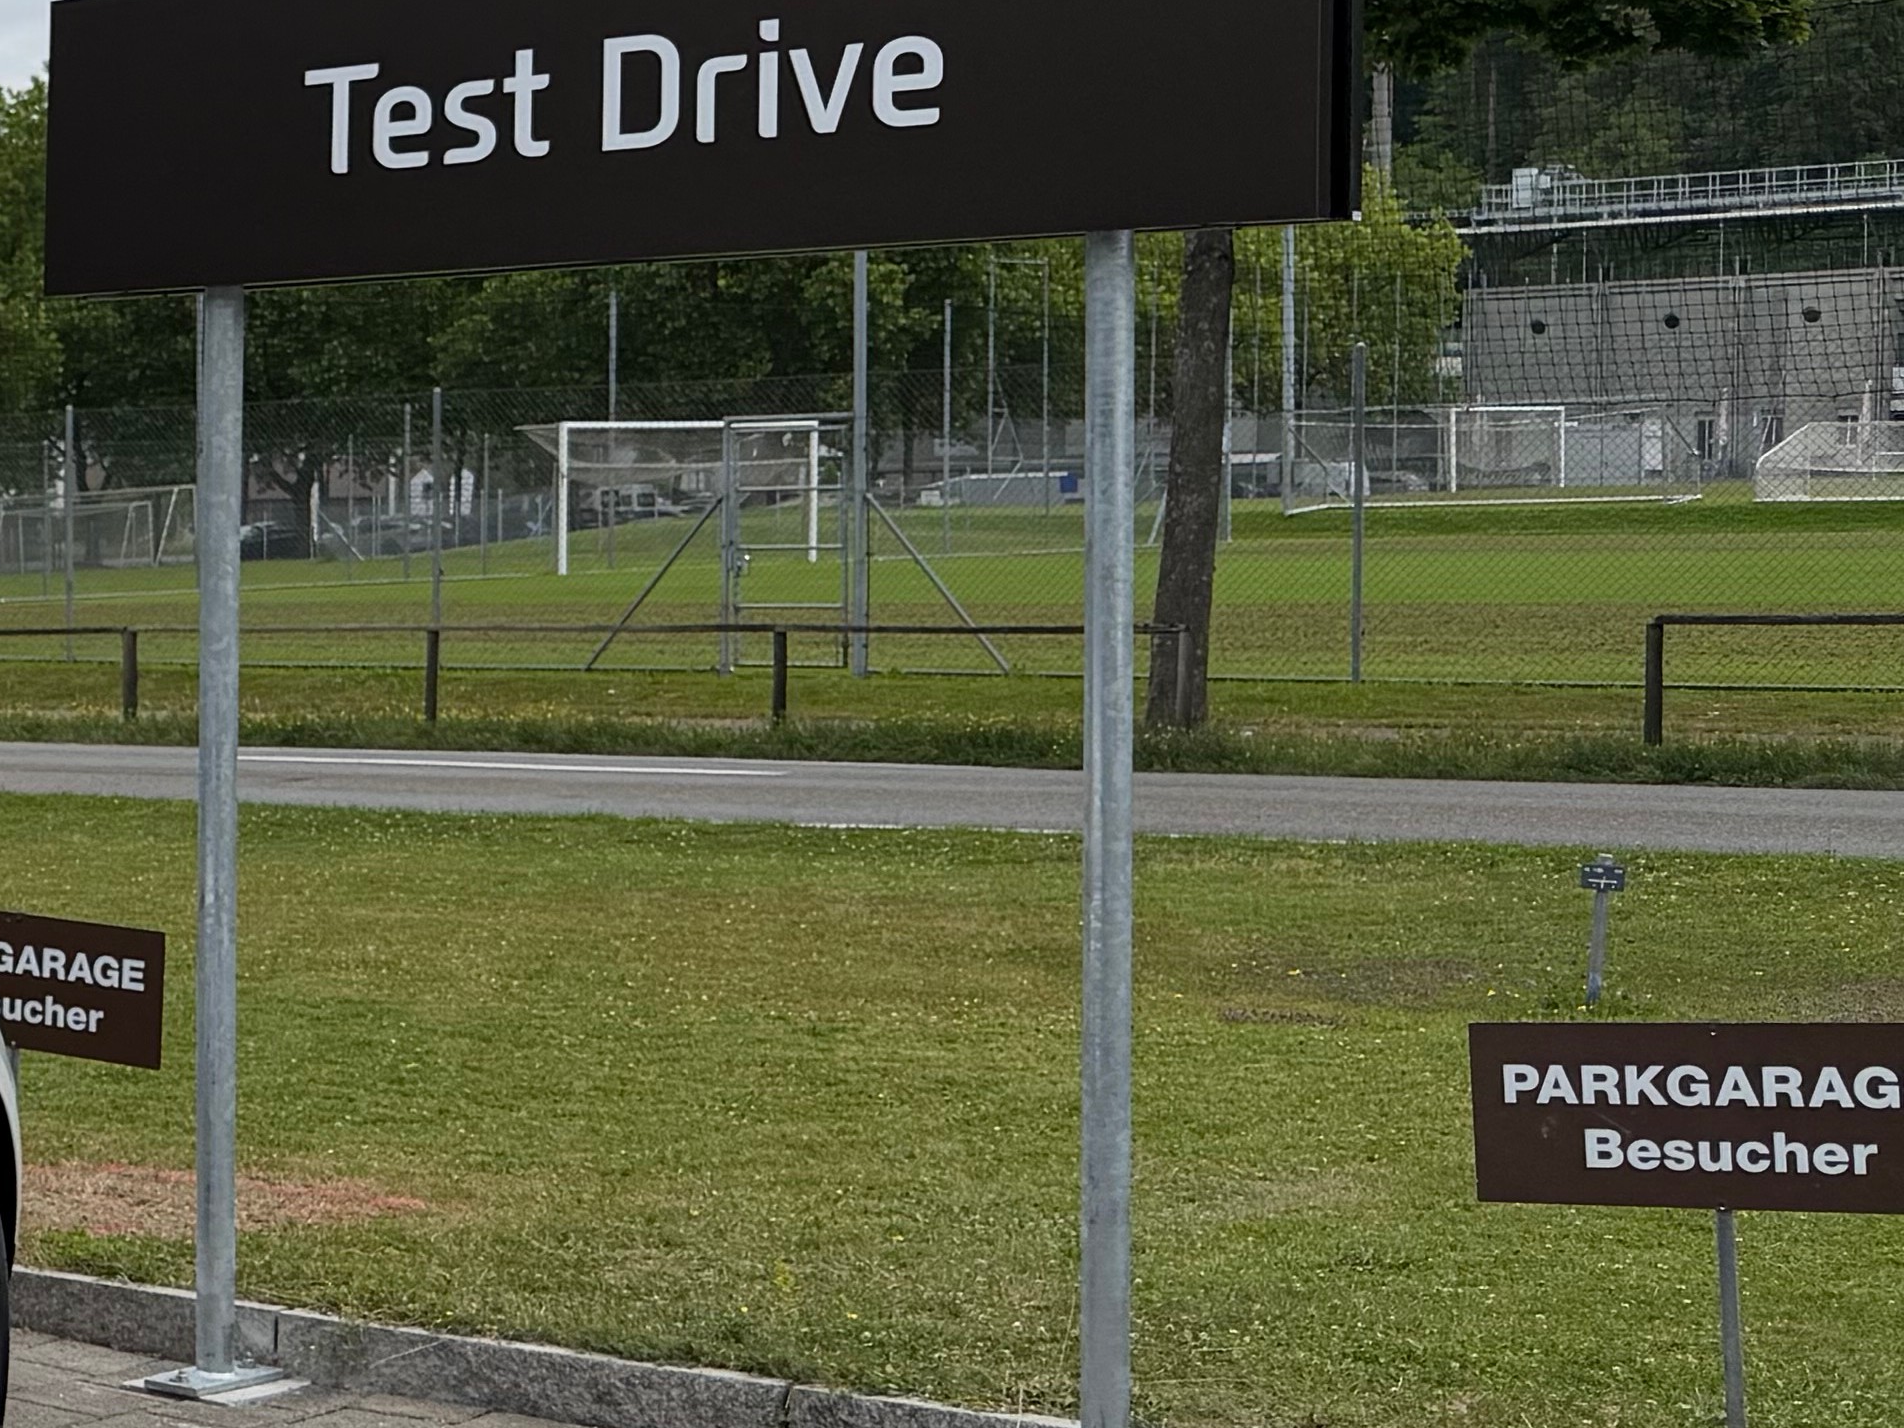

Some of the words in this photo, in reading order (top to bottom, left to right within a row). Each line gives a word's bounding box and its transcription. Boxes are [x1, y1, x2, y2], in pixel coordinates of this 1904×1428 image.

[304, 49, 551, 174] Test
[602, 18, 945, 153] Drive
[1502, 1063, 1901, 1110] PARKGARAG
[1584, 1127, 1878, 1176] Besucher
